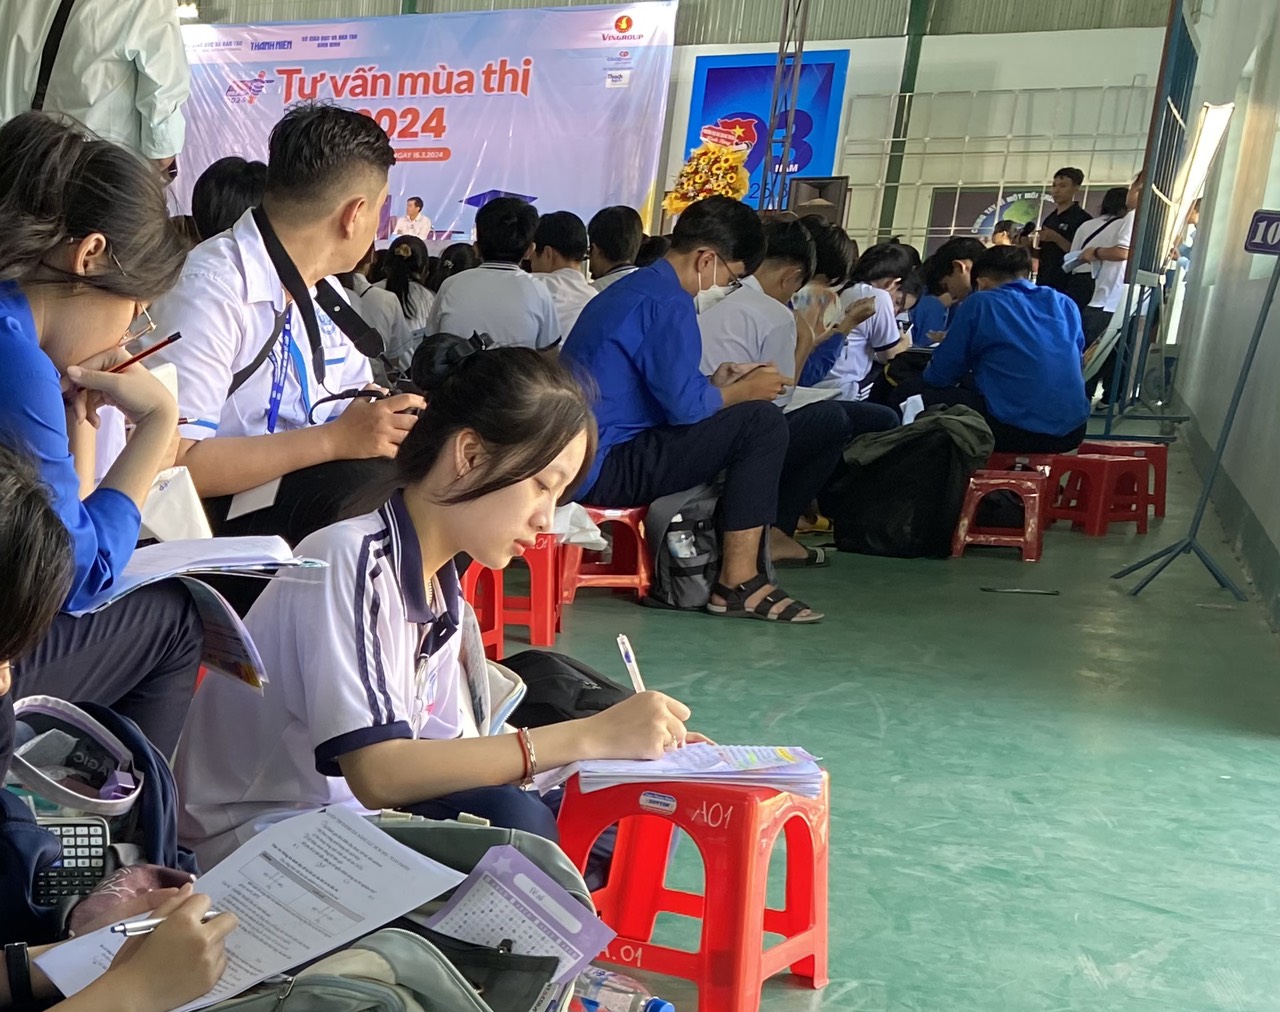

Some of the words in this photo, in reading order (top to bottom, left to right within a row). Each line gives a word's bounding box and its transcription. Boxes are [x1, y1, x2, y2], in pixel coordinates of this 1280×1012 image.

[602, 33, 644, 41] VINGROUP
[275, 68, 325, 104] Tư
[330, 66, 391, 98] vấn
[398, 64, 474, 97] mùa
[358, 107, 446, 138] 024
